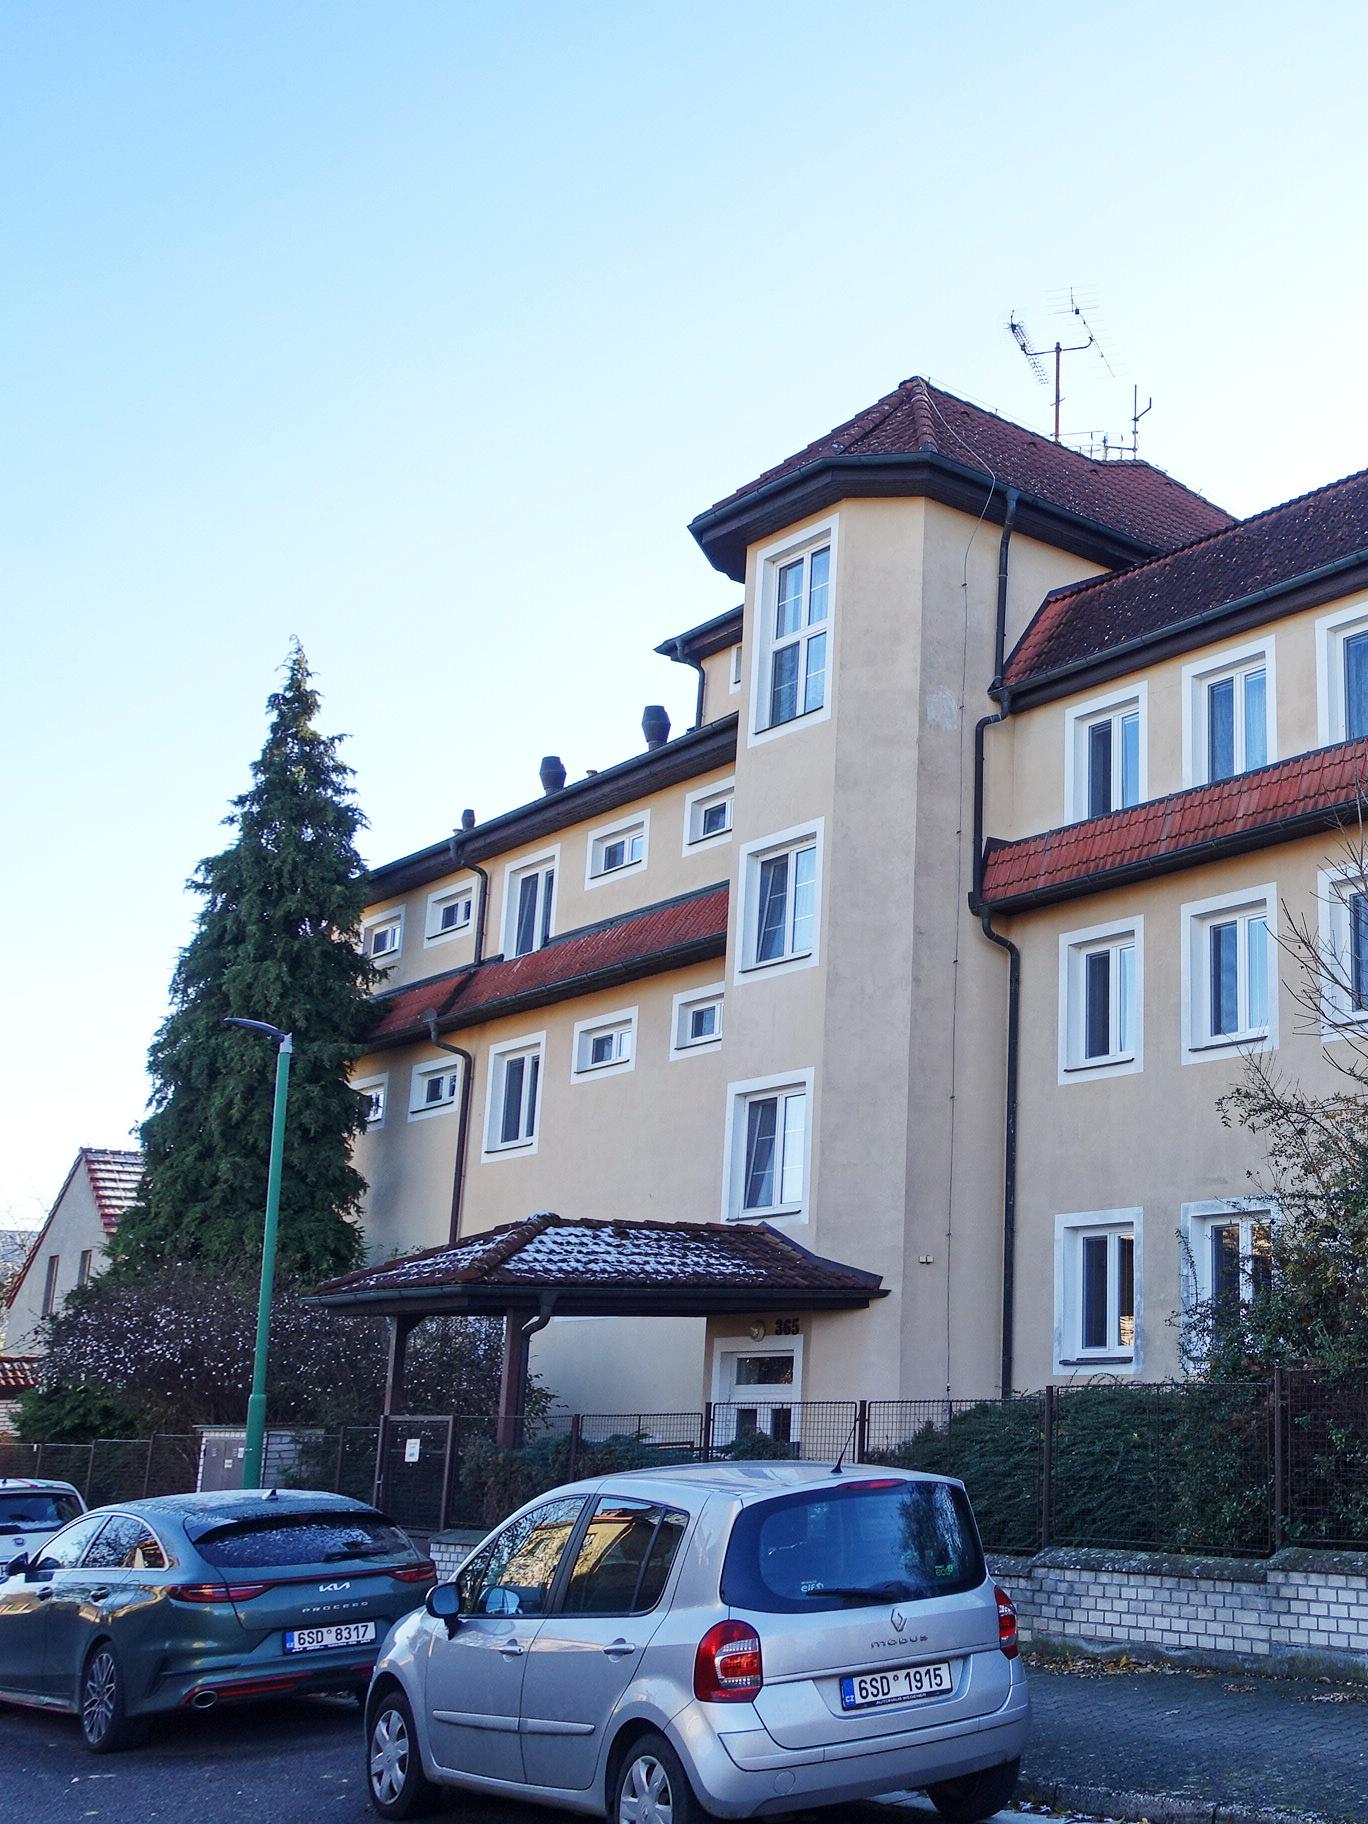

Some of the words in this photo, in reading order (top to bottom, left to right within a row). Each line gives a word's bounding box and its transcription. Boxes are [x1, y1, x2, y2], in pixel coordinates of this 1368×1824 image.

[775, 1318, 800, 1336] 365
[318, 1581, 351, 1592] KIA
[297, 1630, 324, 1646] 6SD
[335, 1624, 369, 1641] 8317
[858, 1676, 891, 1700] 6SD
[904, 1667, 944, 1692] 1915
